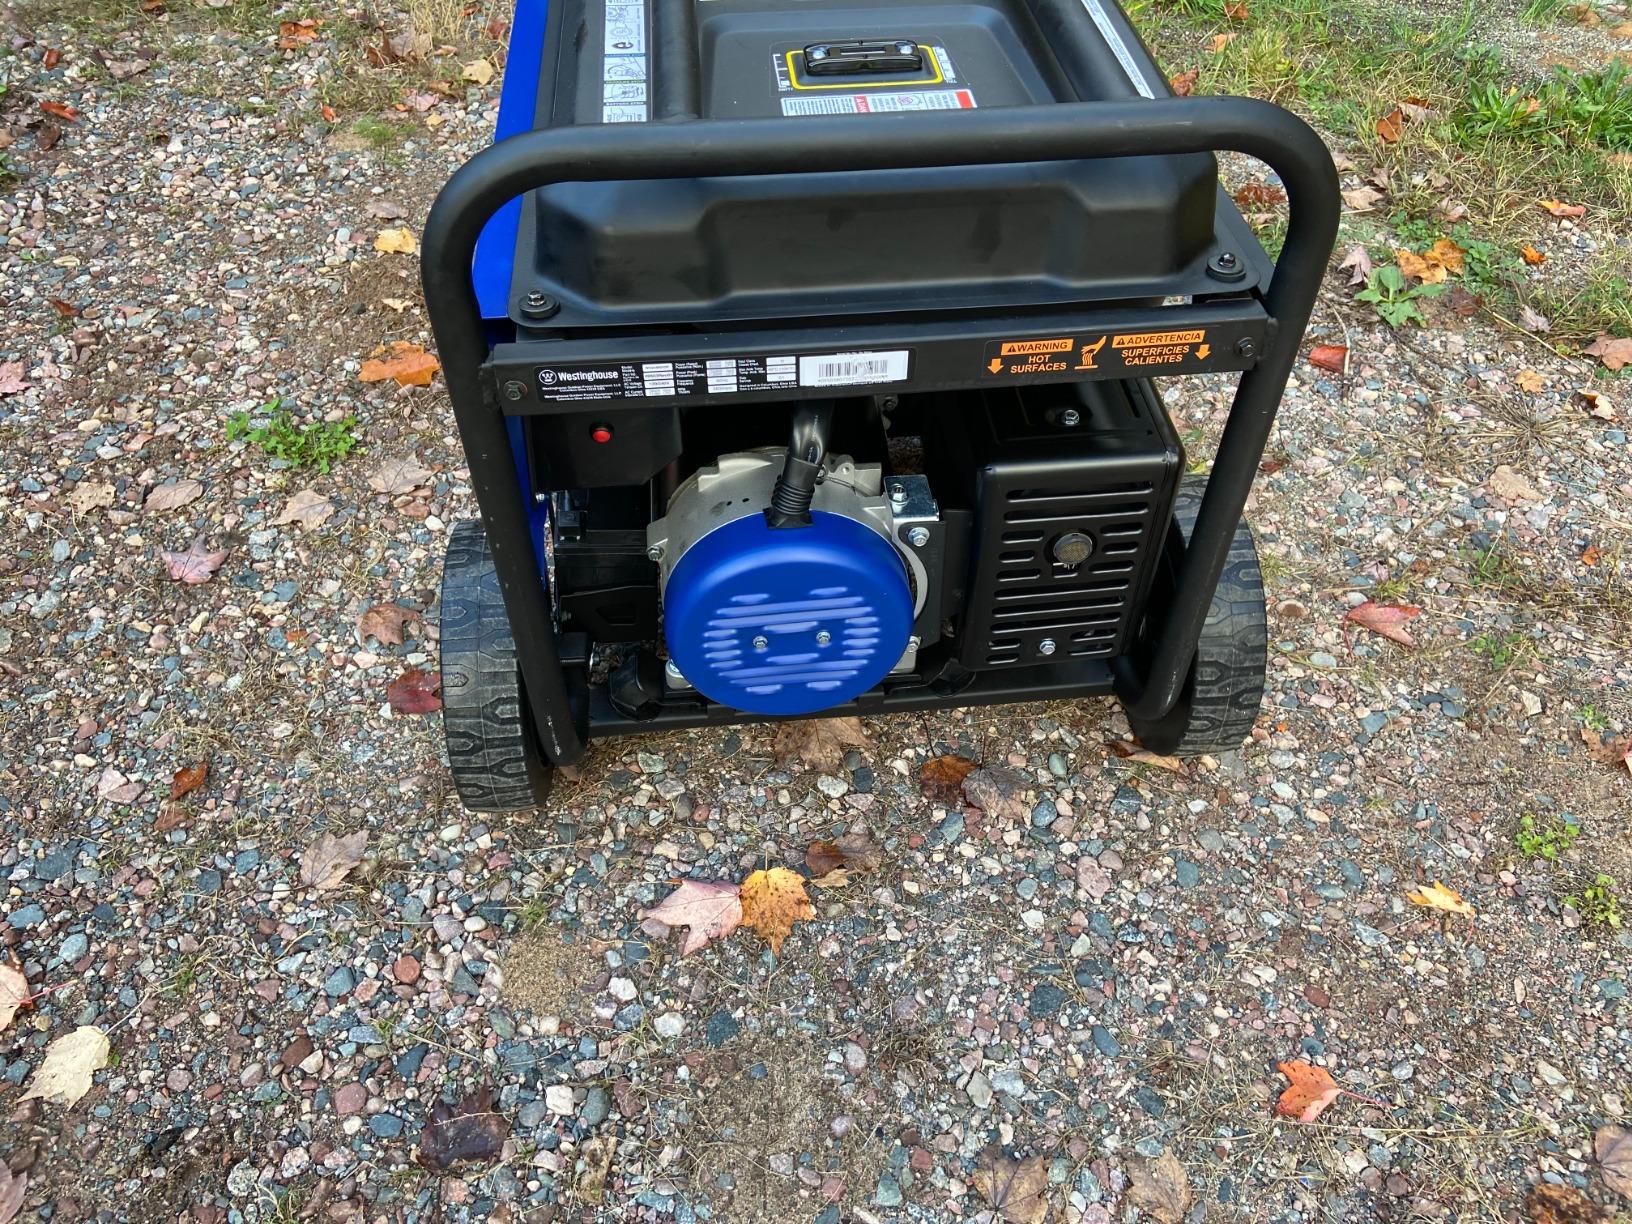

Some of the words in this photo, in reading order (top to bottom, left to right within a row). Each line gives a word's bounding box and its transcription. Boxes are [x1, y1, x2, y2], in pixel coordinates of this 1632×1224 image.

[1127, 333, 1201, 345] ADVERTENCIA
[1016, 342, 1068, 352] WARNING
[1121, 346, 1190, 357] SUPERFICIES
[1028, 355, 1051, 363] HOT
[1125, 355, 1183, 366] CALIENTES
[1010, 363, 1067, 373] SURFACES
[558, 371, 619, 382] Westinghouse
